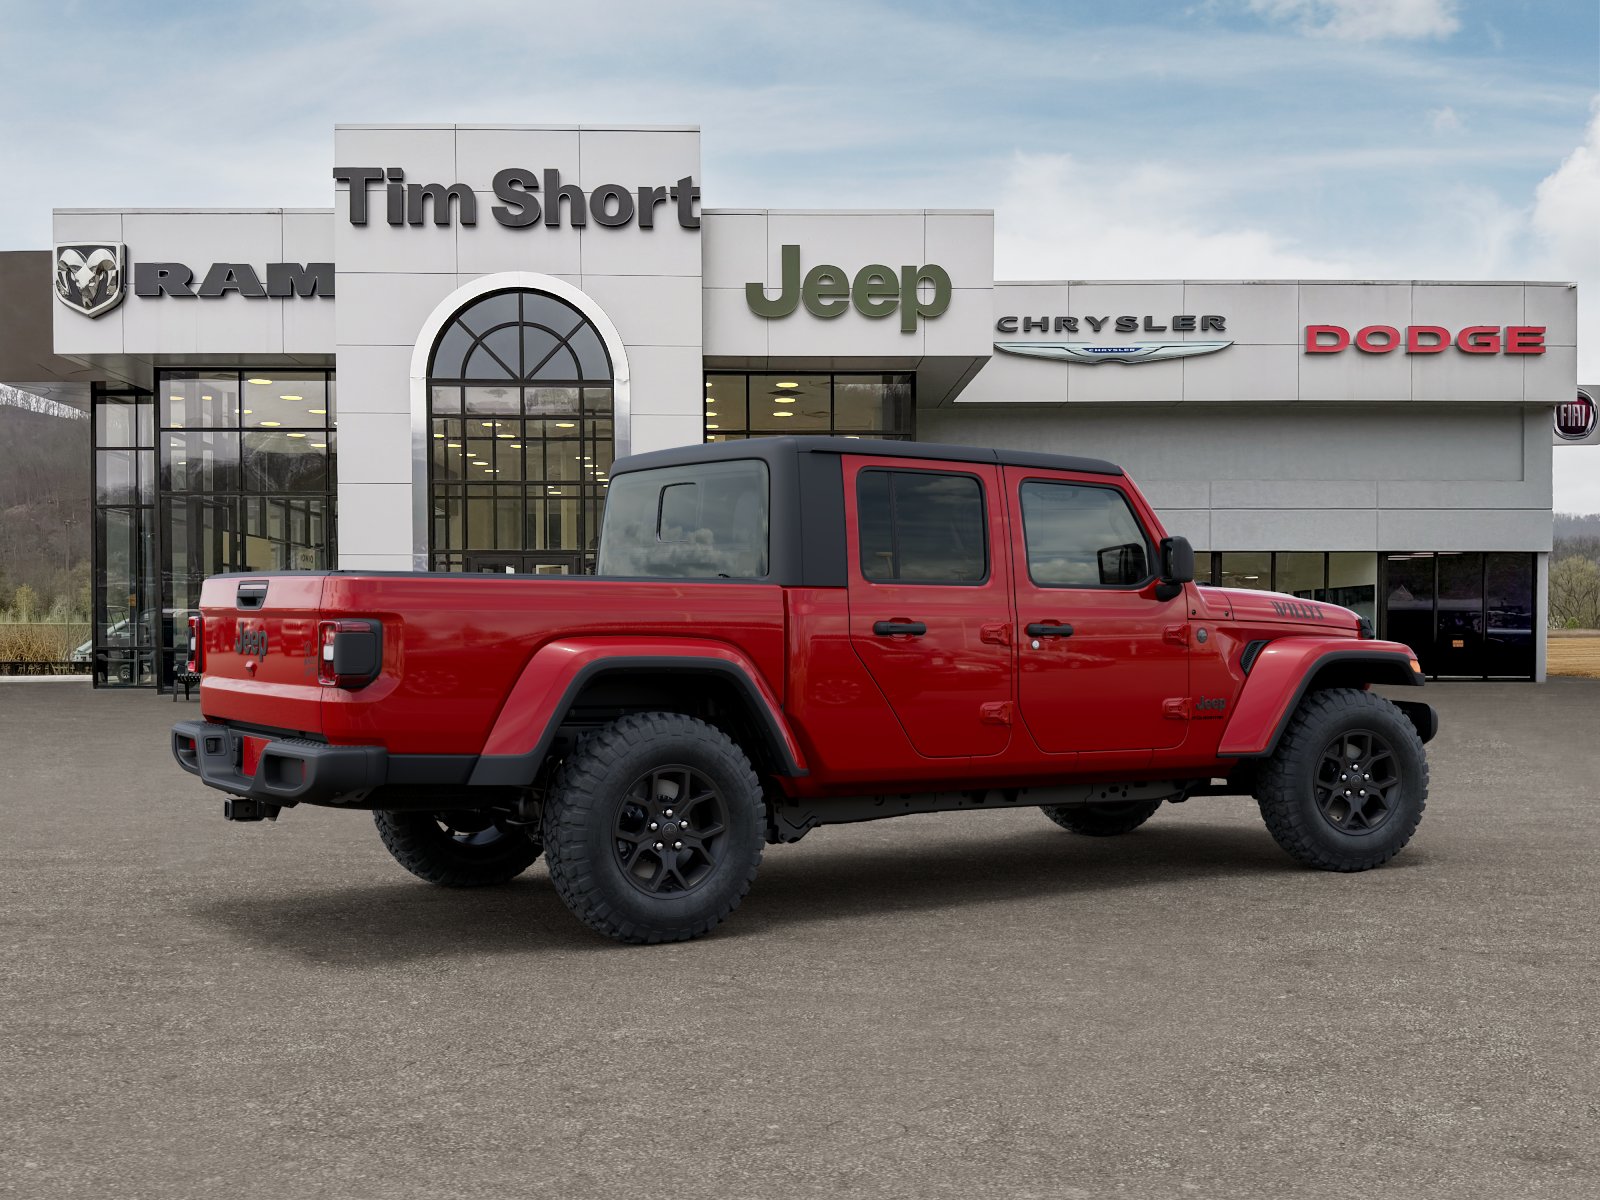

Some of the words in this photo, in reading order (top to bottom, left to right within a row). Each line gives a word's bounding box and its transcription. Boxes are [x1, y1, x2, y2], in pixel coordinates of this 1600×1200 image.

[333, 167, 477, 227] Tim
[491, 167, 701, 229] Short
[134, 262, 336, 298] RAM
[745, 244, 953, 333] Jeep
[997, 315, 1227, 332] CHRYSLER
[1303, 324, 1547, 354] DODGE
[1560, 404, 1586, 427] FIAT
[1270, 600, 1324, 620] WILLYS
[235, 621, 268, 663] Jeep
[1195, 695, 1226, 712] Jeep
